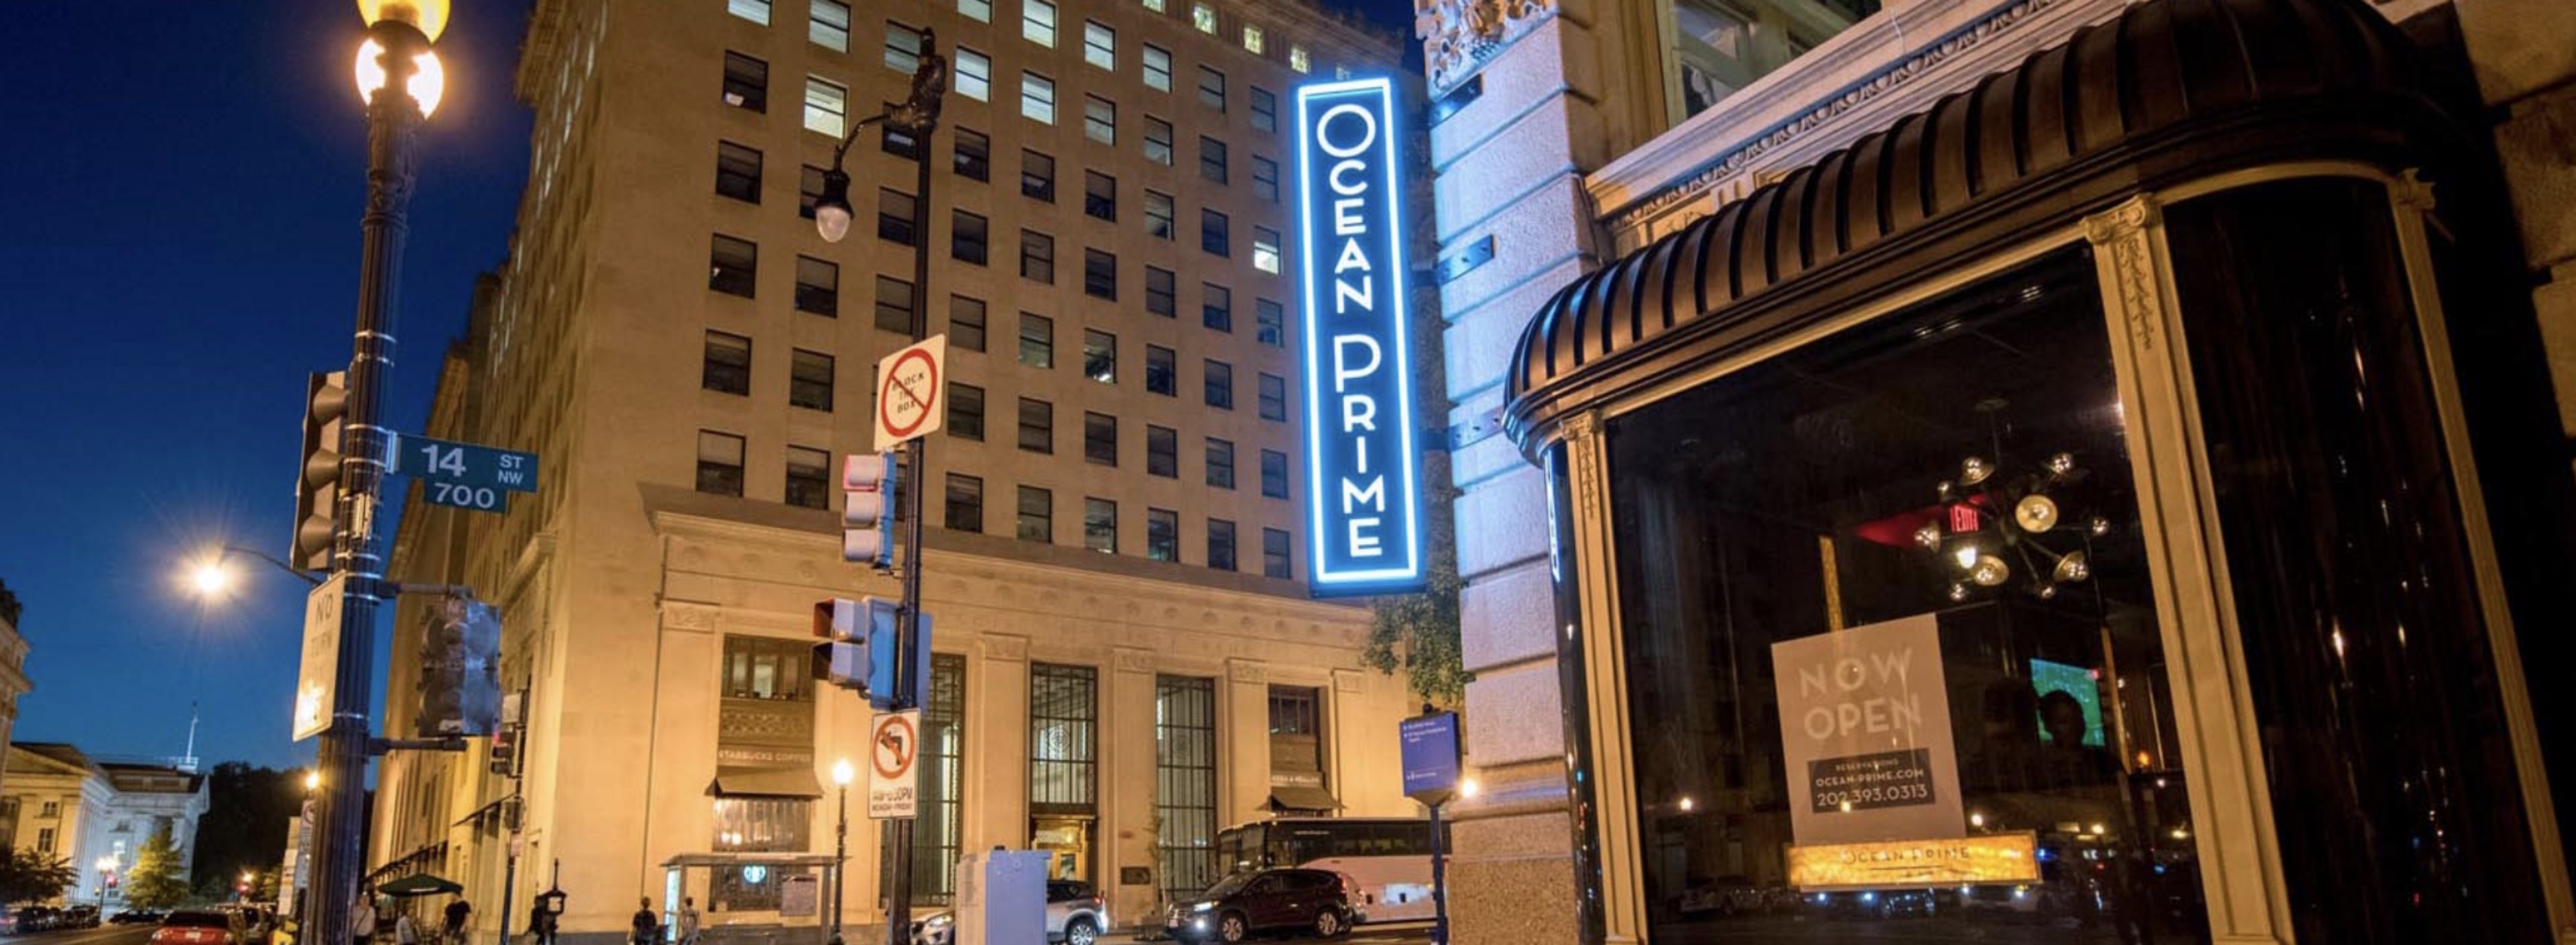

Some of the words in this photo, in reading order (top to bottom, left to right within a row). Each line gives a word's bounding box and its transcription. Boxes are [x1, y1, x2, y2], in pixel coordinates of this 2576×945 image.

[1316, 103, 1377, 314] OCEAN
[897, 401, 916, 413] BOX
[421, 444, 466, 477] 14
[499, 454, 524, 468] ST
[1333, 334, 1385, 558] PRIME
[498, 470, 523, 485] NW
[434, 482, 495, 509] 700
[1799, 647, 1912, 699] NOW
[1804, 693, 1921, 740] OPEN
[1817, 784, 1927, 806] 202393.0313
